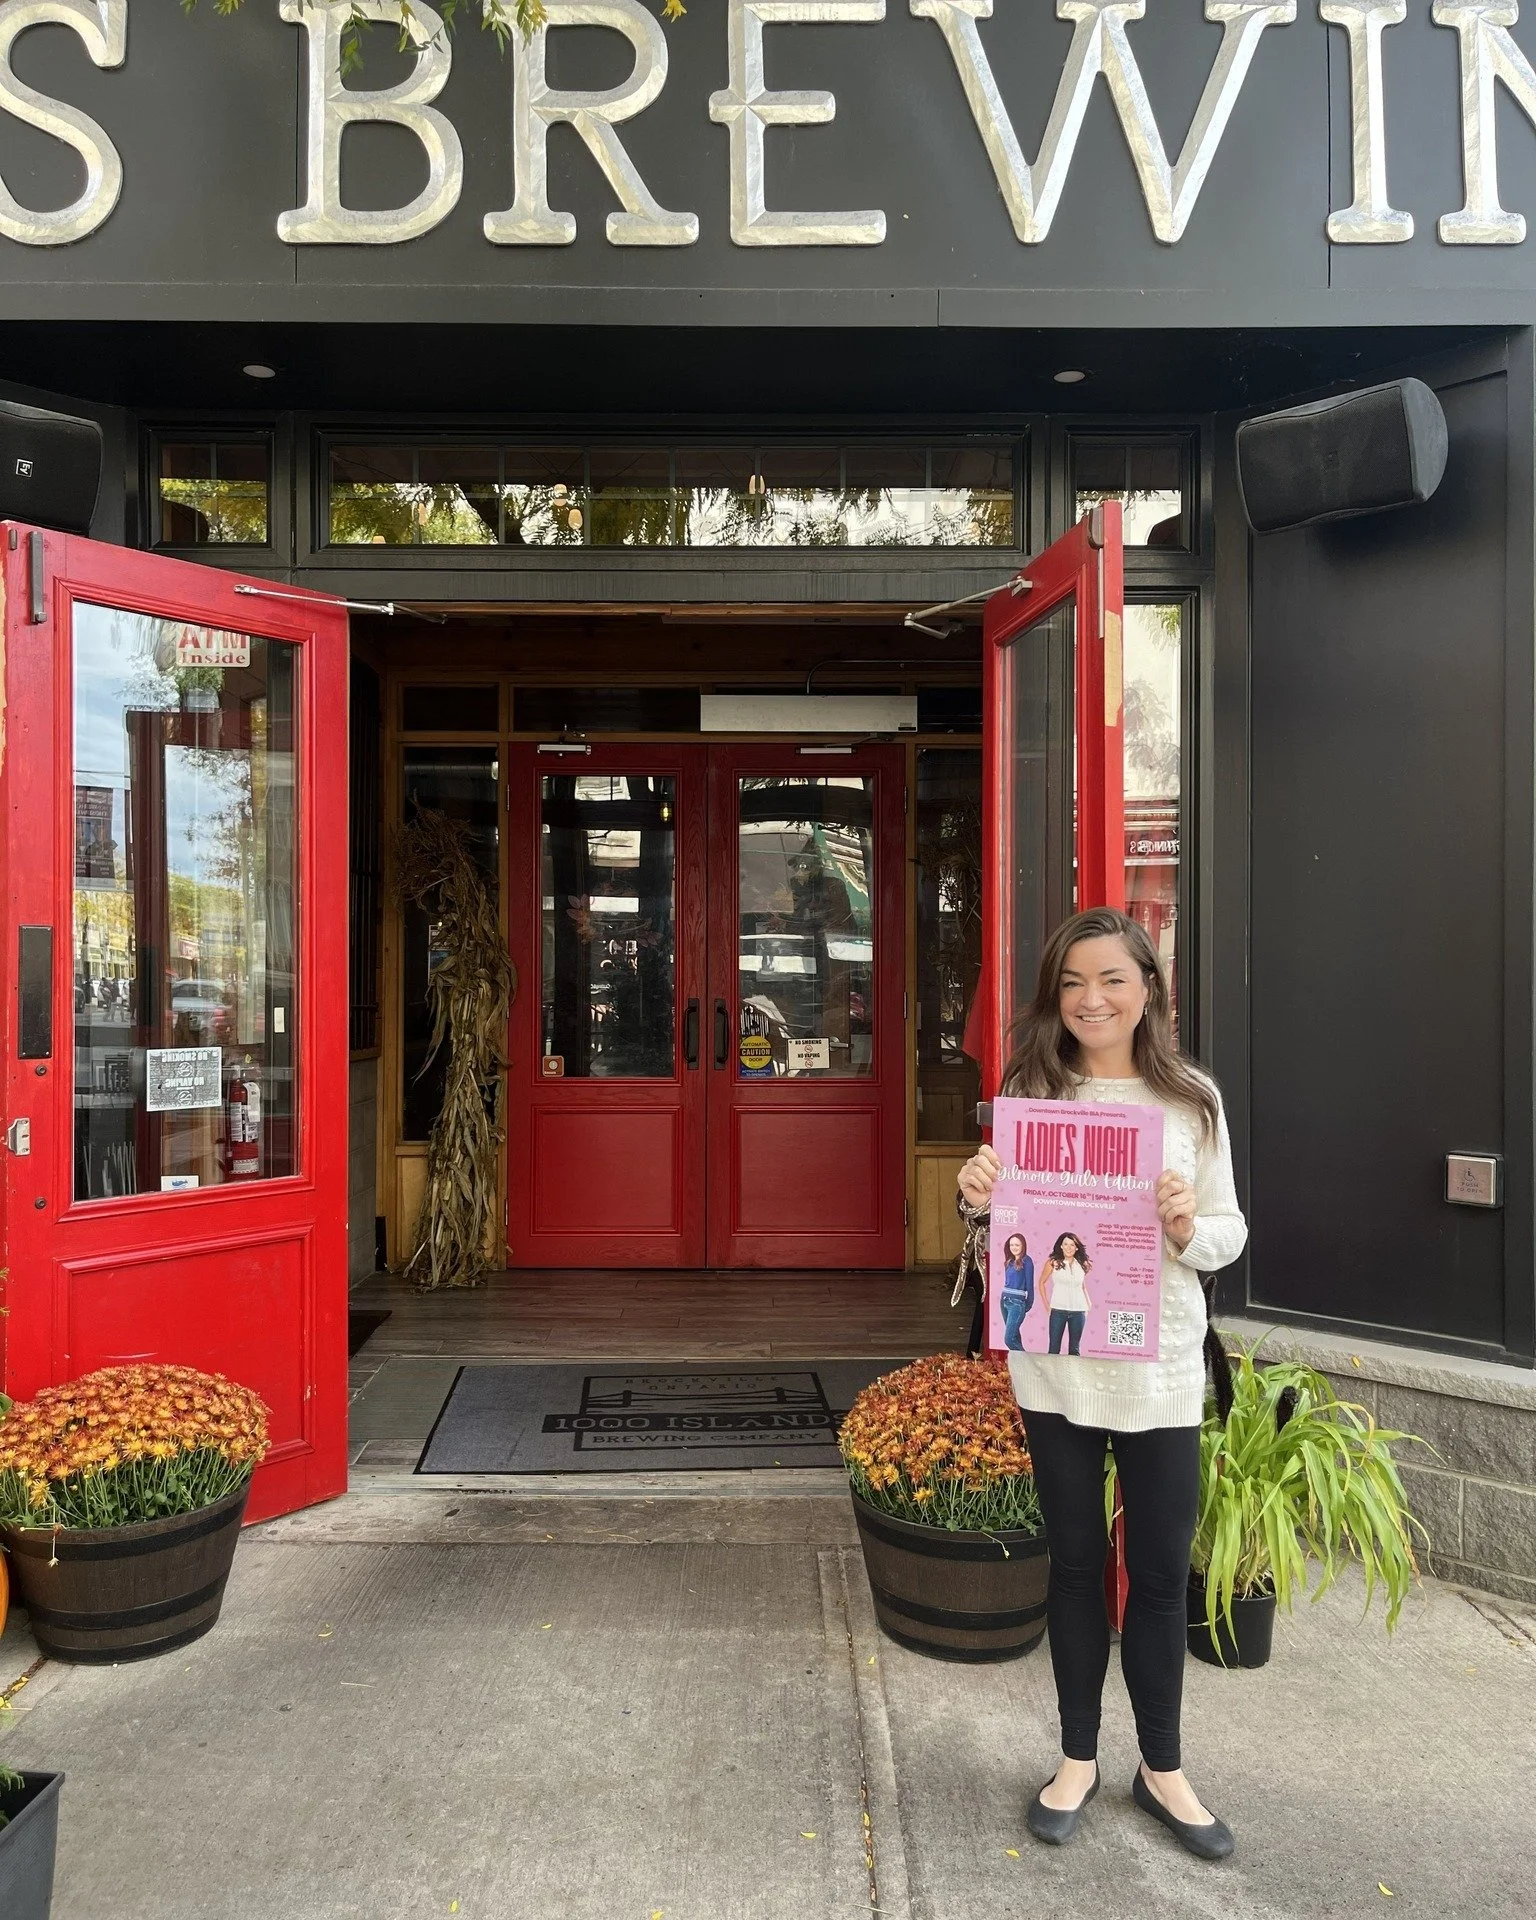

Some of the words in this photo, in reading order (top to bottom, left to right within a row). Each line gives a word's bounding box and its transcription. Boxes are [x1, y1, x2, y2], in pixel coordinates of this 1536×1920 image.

[178, 624, 246, 648] ATM
[181, 651, 246, 664] Inside
[1015, 1120, 1077, 1174] LADIES
[1083, 1124, 1139, 1177] NIGHT
[1104, 1171, 1155, 1191] Edition
[1048, 1190, 1079, 1198] OCTOBER
[1034, 1198, 1076, 1206] DOWNTOWN
[1077, 1201, 1116, 1209] BROCKVILLE
[994, 1208, 1018, 1217] BROCK
[995, 1216, 1018, 1224] VILLE
[626, 1376, 779, 1384] BROCKVILLE
[555, 1417, 650, 1430] 1000
[593, 1435, 701, 1443] BREWING
